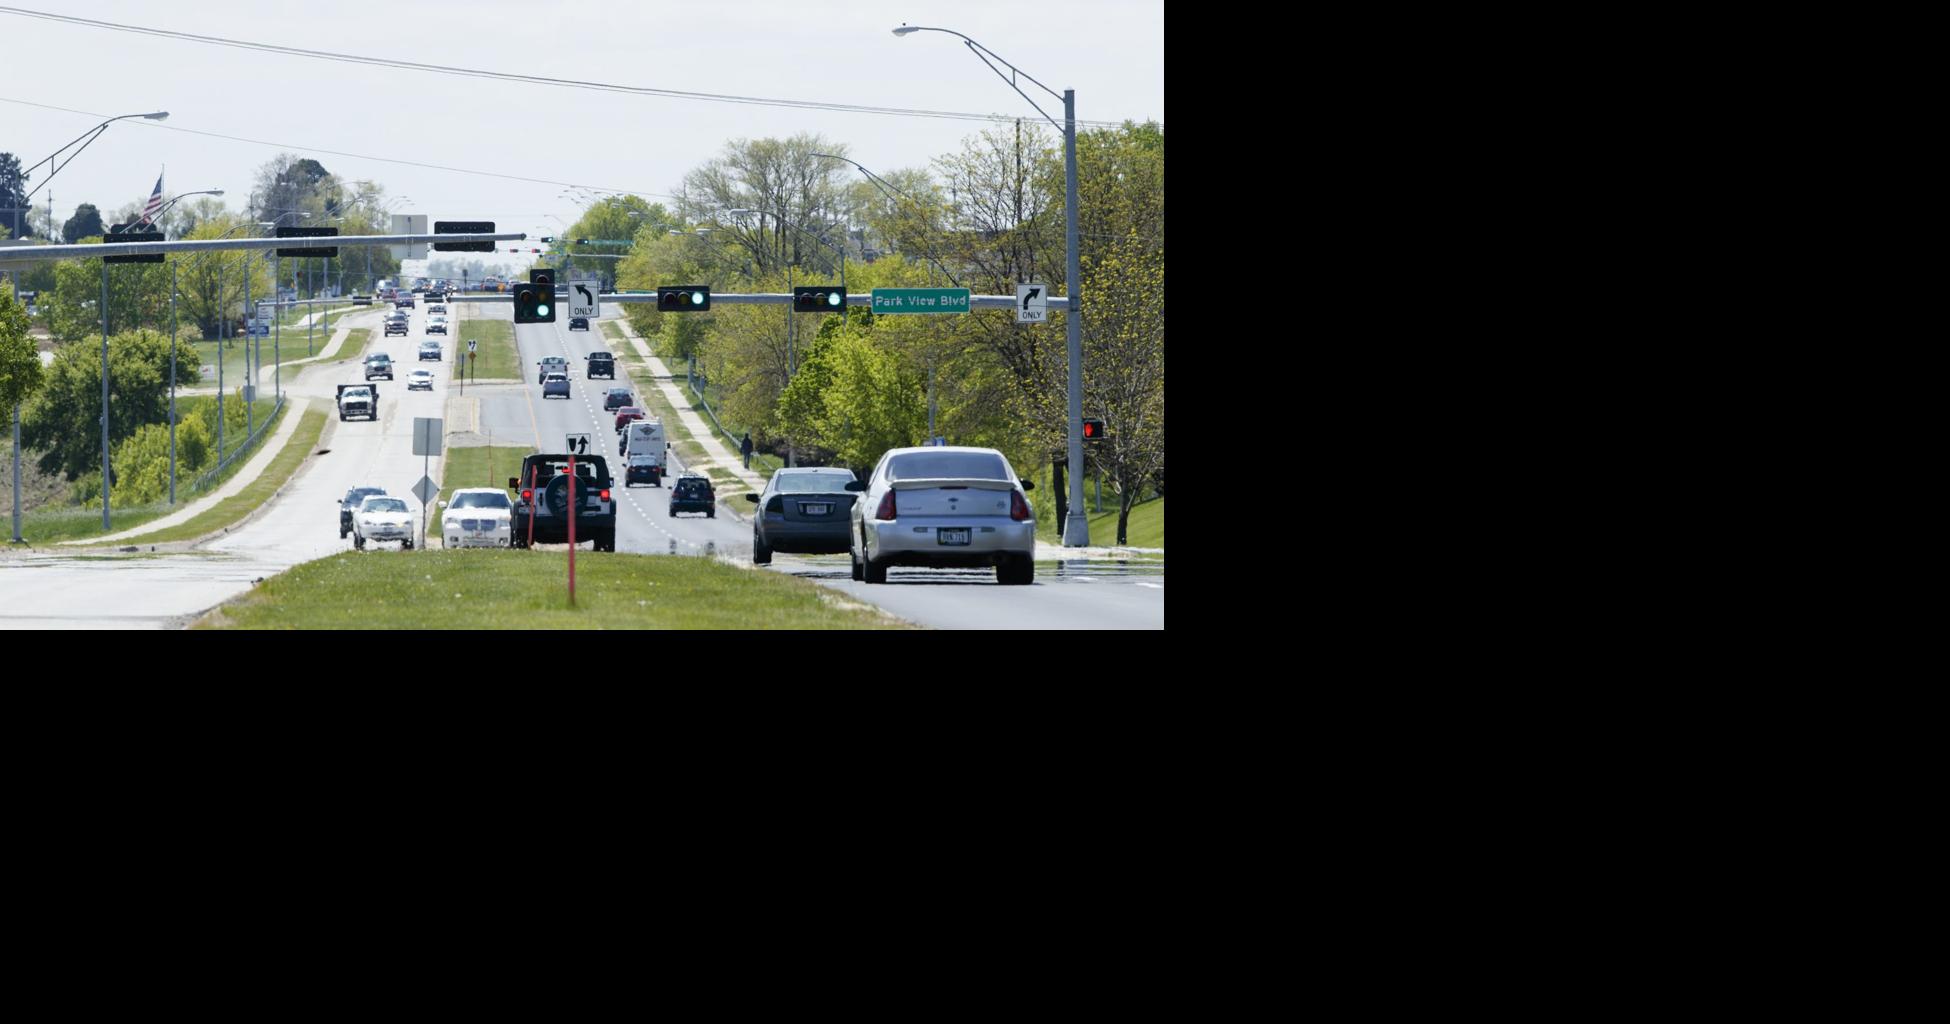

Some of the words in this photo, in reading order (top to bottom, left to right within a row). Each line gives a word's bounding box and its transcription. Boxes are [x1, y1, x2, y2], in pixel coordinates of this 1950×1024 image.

[875, 296, 903, 306] Park
[908, 296, 936, 306] View
[940, 296, 966, 306] Blvd
[574, 307, 593, 315] ONLY
[1022, 311, 1042, 319] ONLY
